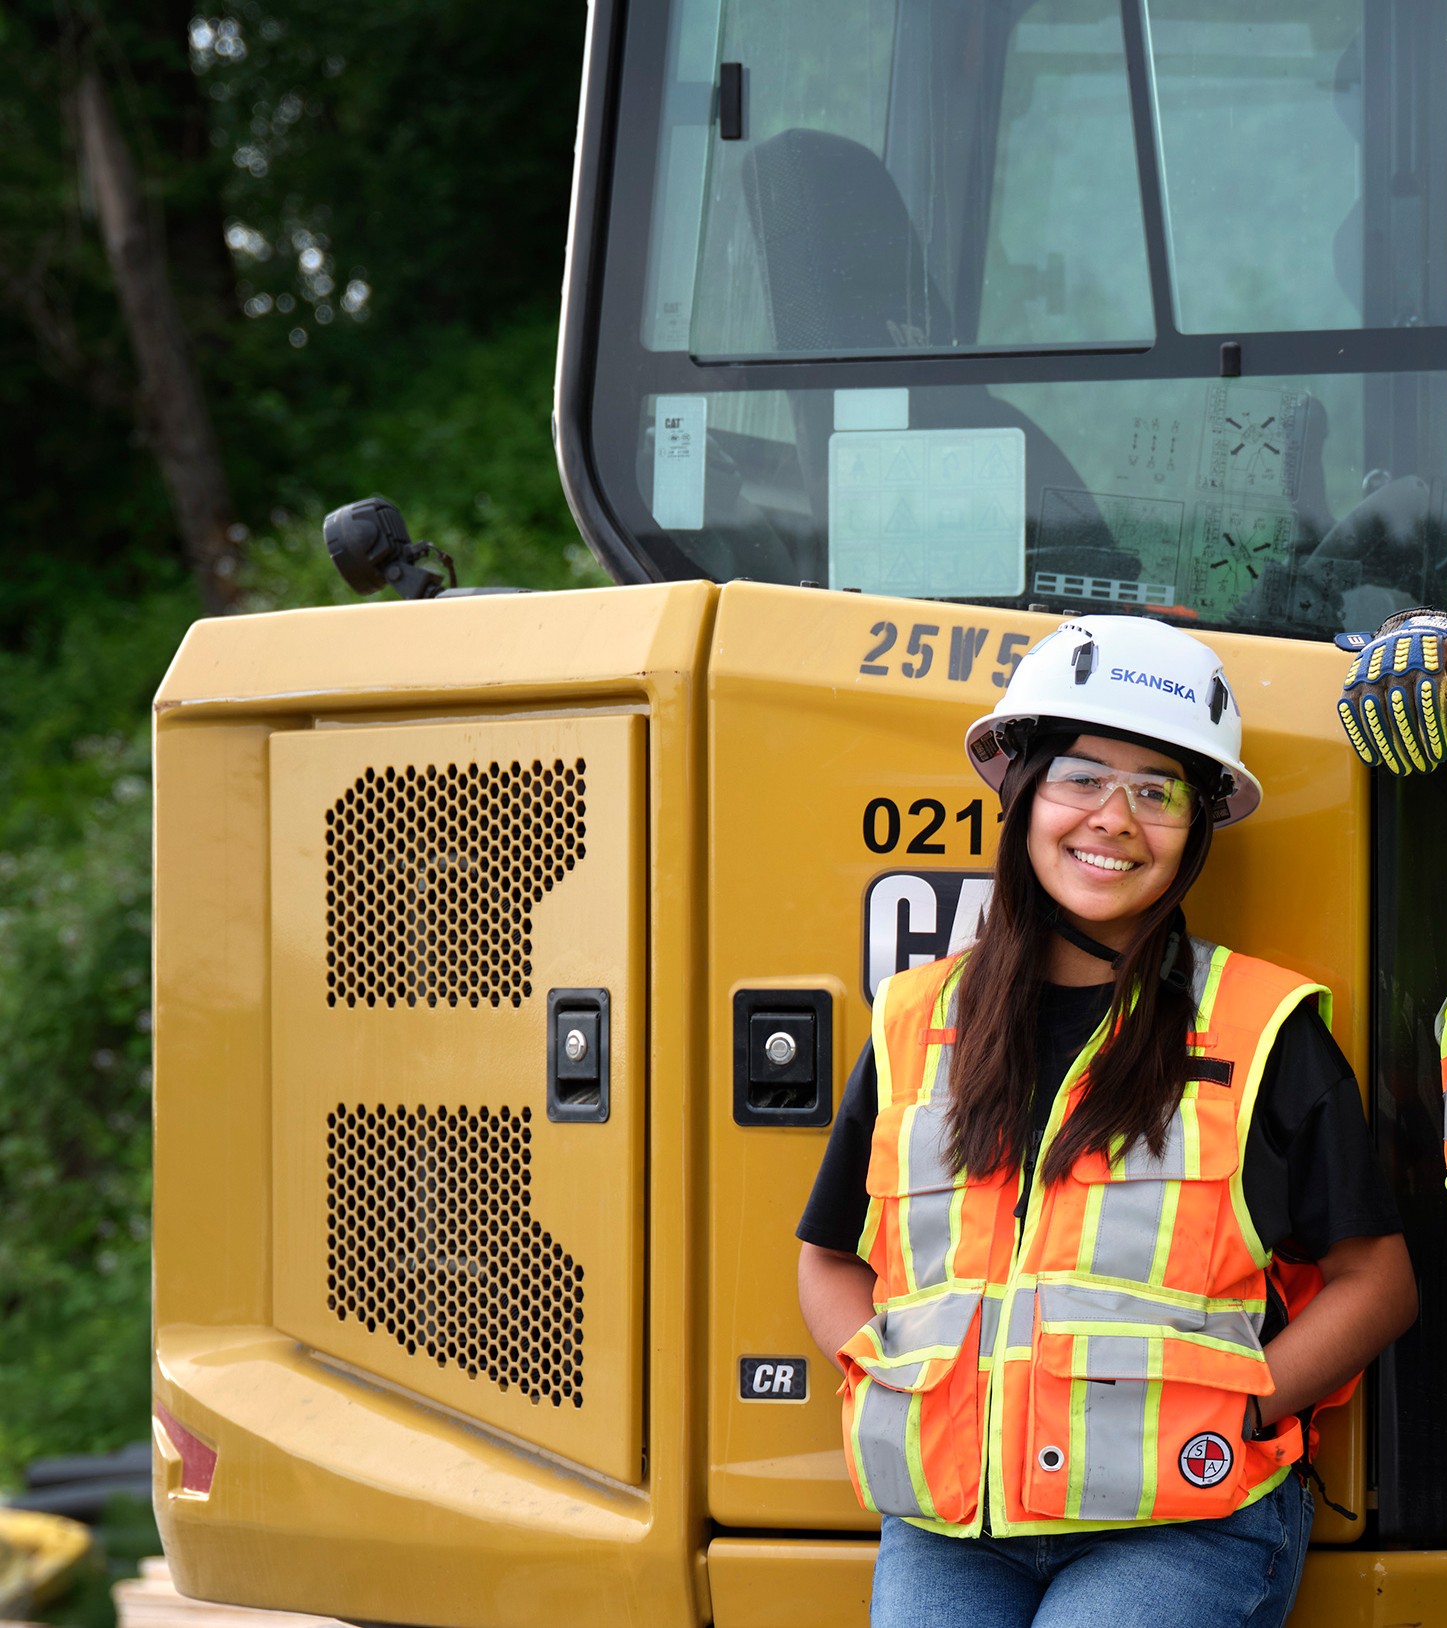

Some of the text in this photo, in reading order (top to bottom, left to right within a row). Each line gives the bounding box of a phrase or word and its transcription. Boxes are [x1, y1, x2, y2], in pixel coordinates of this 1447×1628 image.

[664, 417, 681, 429] CAT
[1110, 667, 1196, 703] SKANSKA
[863, 797, 1003, 855] 021
[752, 1364, 794, 1393] CR
[1194, 1444, 1203, 1457] S
[1205, 1461, 1217, 1473] A
